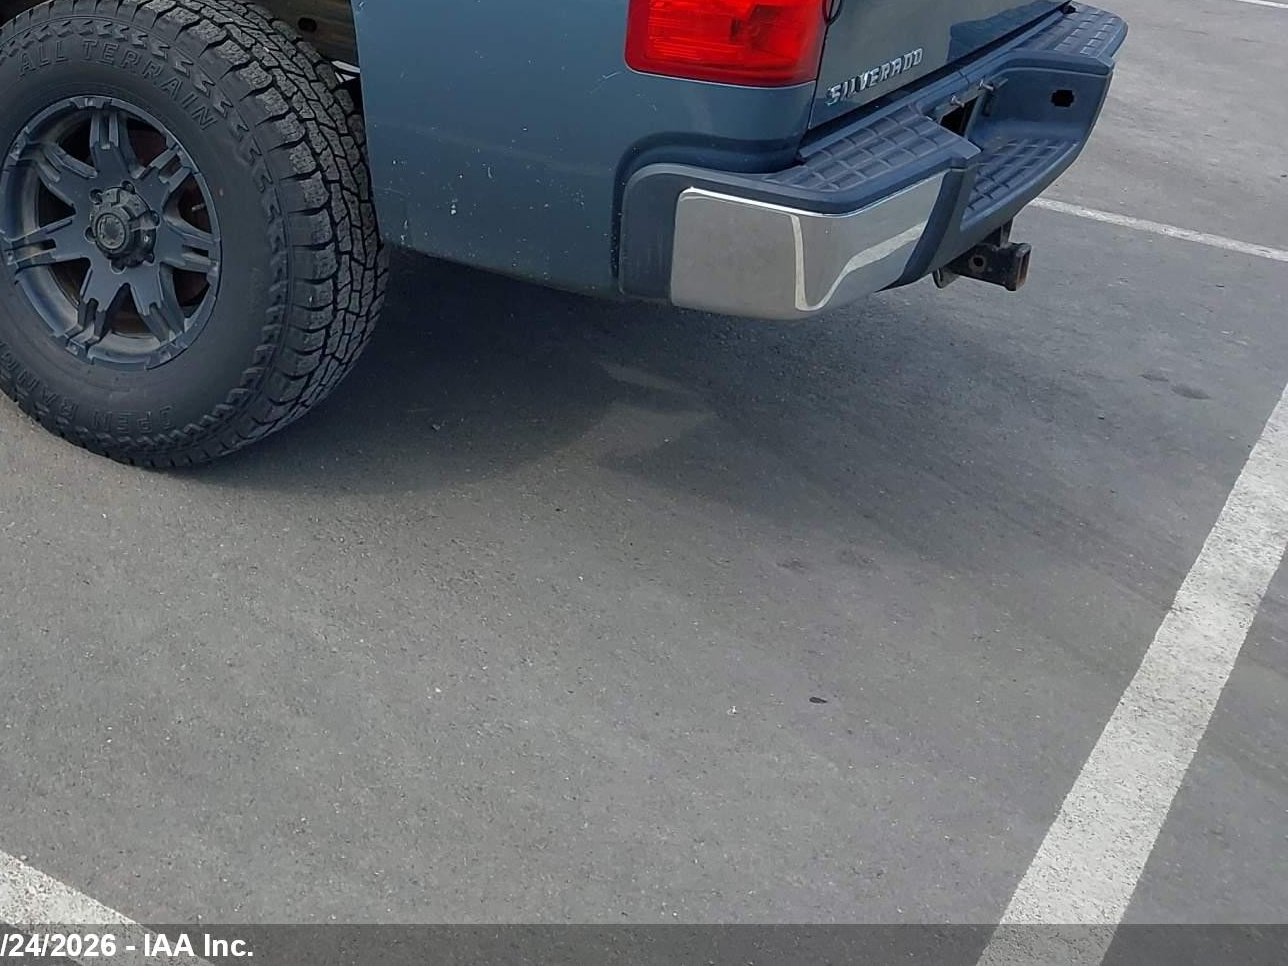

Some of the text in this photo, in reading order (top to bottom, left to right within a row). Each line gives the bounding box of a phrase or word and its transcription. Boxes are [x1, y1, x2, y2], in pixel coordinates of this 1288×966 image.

[17, 38, 218, 131] ALL TERRAIN
[825, 48, 923, 106] SILVERADO
